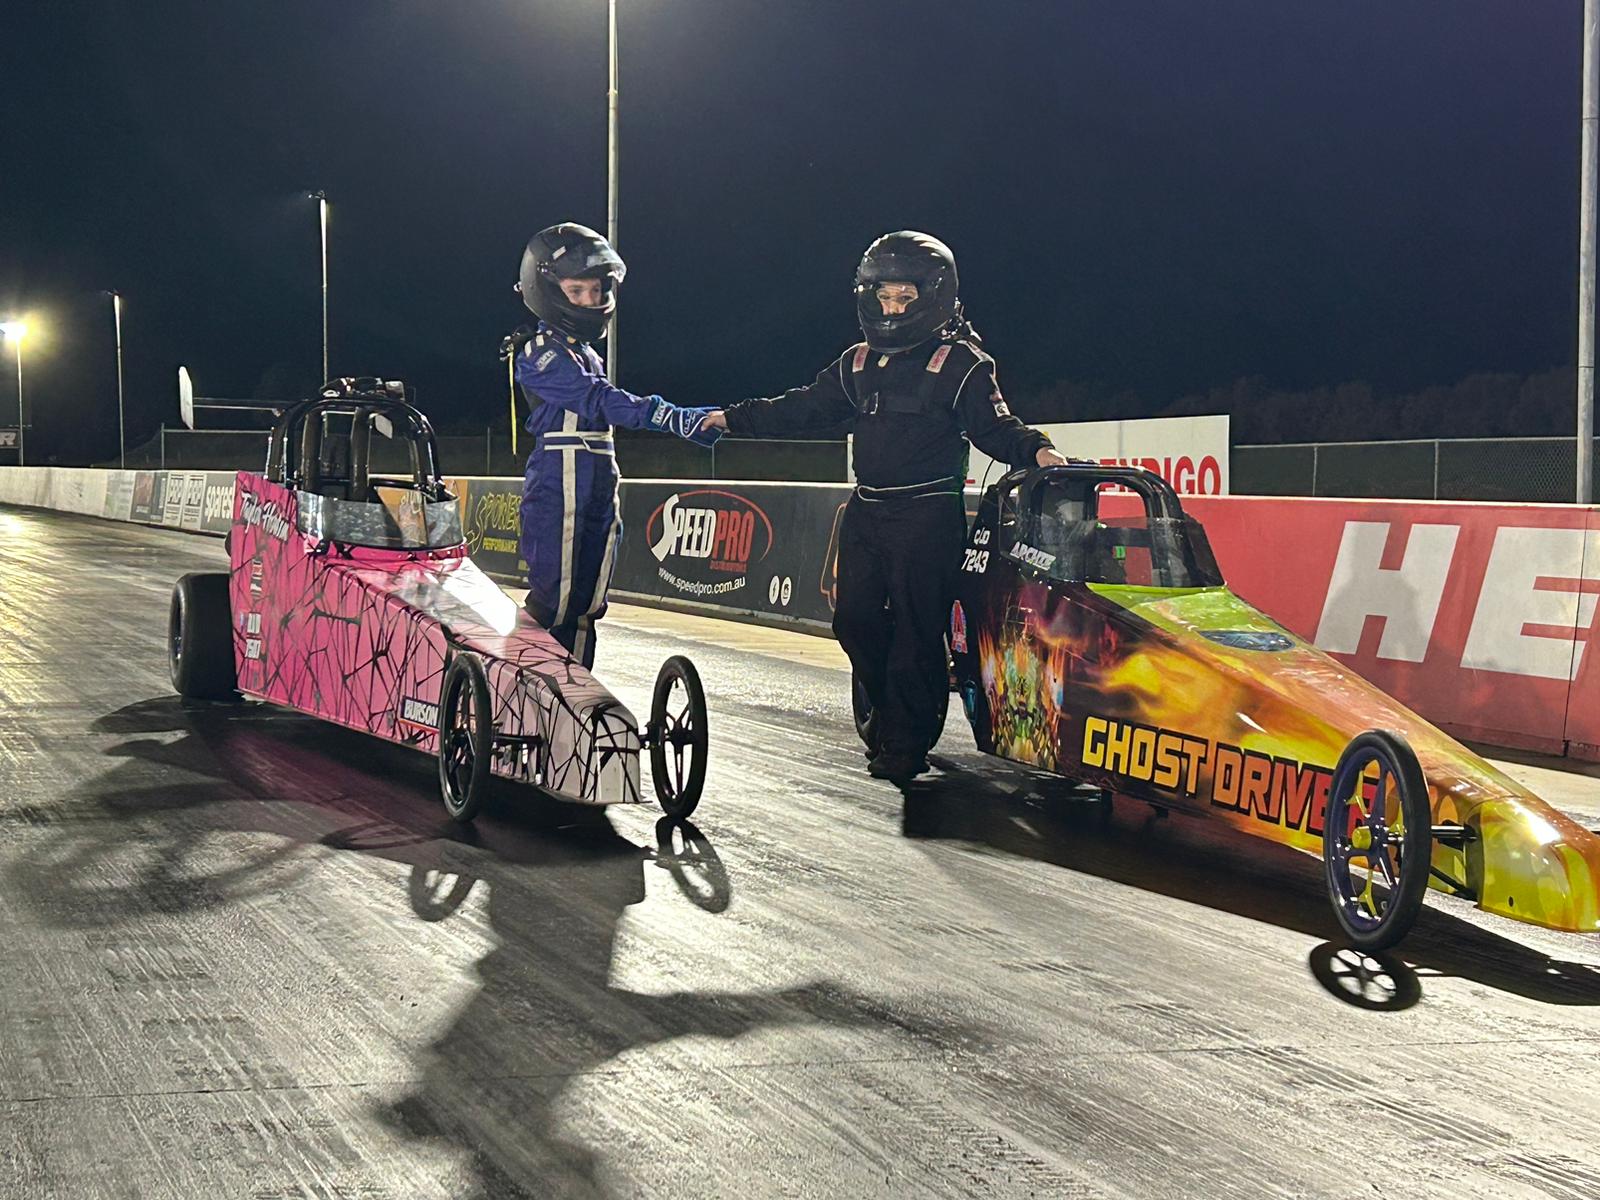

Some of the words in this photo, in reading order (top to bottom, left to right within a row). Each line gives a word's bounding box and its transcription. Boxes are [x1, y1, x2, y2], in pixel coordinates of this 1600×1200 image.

[961, 548, 990, 574] 7243
[658, 566, 746, 596] www.speedpro.com.au
[404, 699, 439, 727] BURSON
[1081, 716, 1207, 795] GHOST
